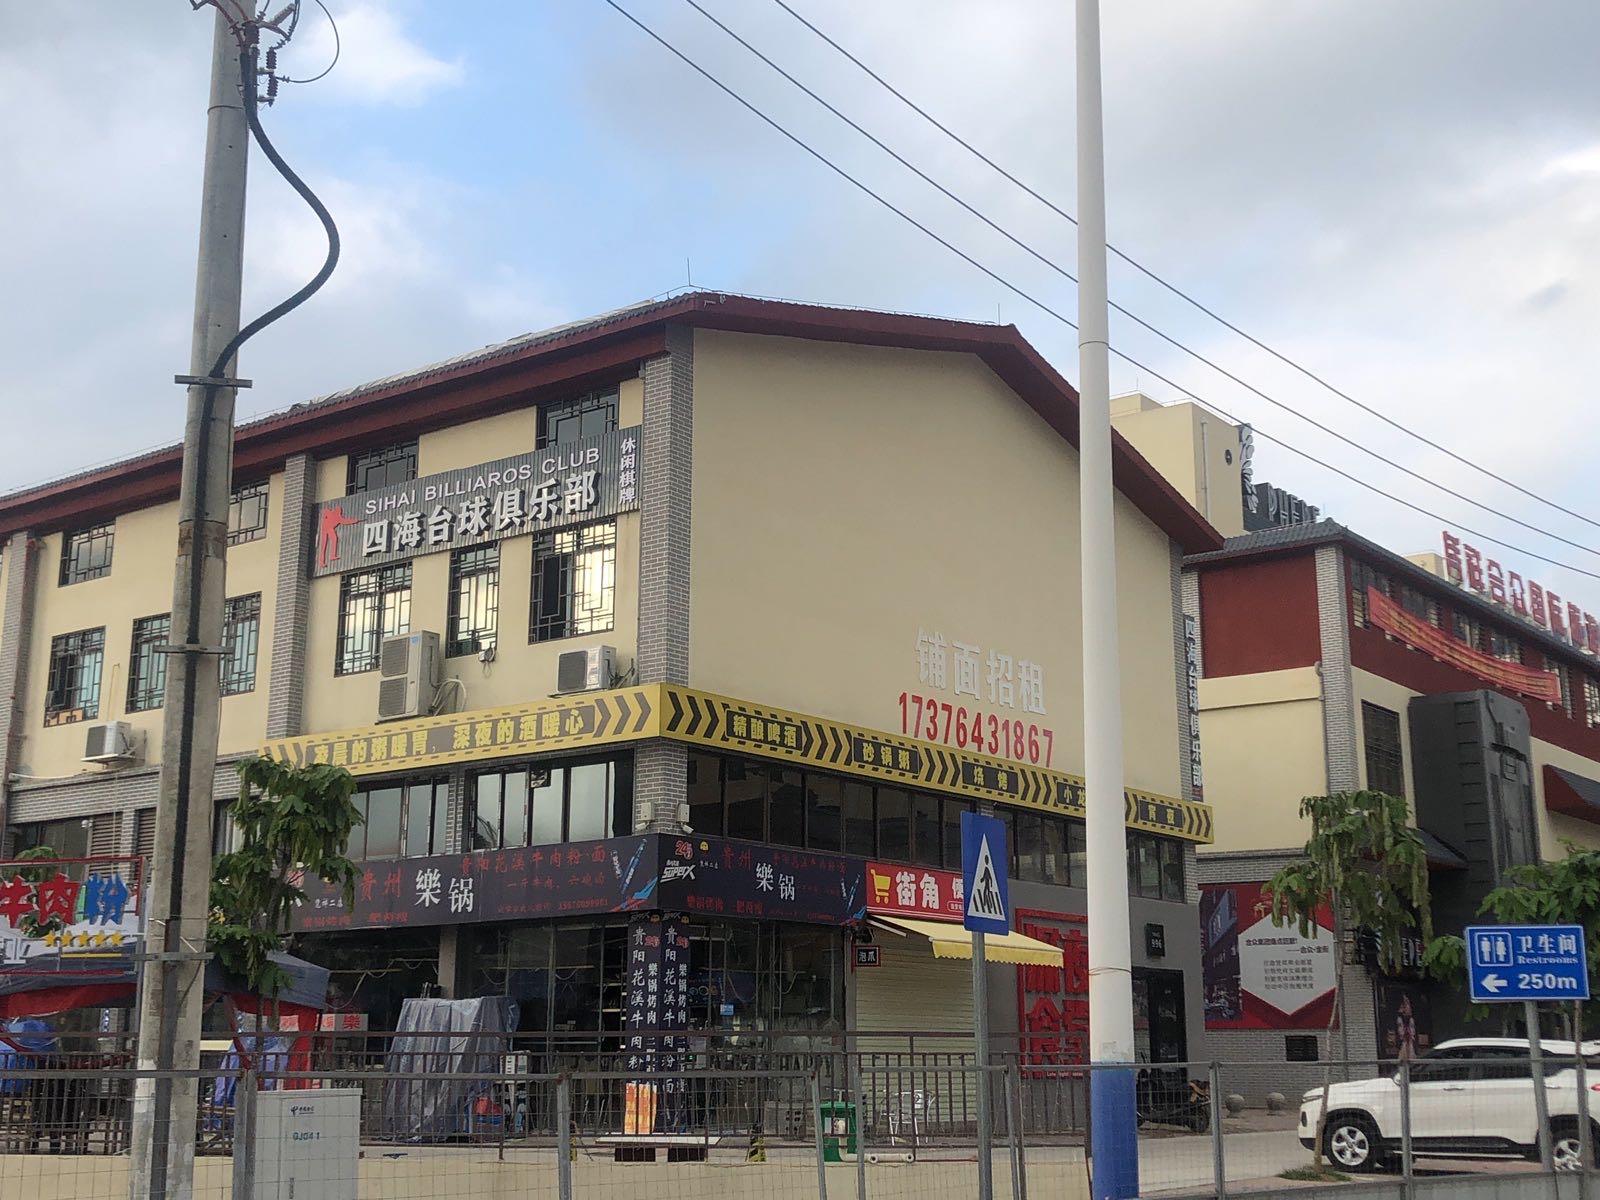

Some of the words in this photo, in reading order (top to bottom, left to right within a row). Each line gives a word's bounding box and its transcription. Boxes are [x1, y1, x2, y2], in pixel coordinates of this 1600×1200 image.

[365, 490, 416, 515] SIHAI
[425, 465, 531, 501] BILLIAROS
[541, 447, 600, 474] CLUB
[620, 437, 637, 504] 休闲棋牌
[363, 470, 597, 556] 四海台球俱乐部
[914, 625, 1046, 715] 铺面招租
[733, 714, 797, 748] 精酿啤酒
[898, 692, 1053, 768] 17376431867
[863, 742, 910, 770] 砂锅粥
[973, 765, 1008, 791] 烧烤
[361, 868, 405, 900] 贵州
[1516, 934, 1577, 955] 卫生间
[1517, 955, 1578, 965] Restrooms
[1518, 973, 1577, 989] 250m
